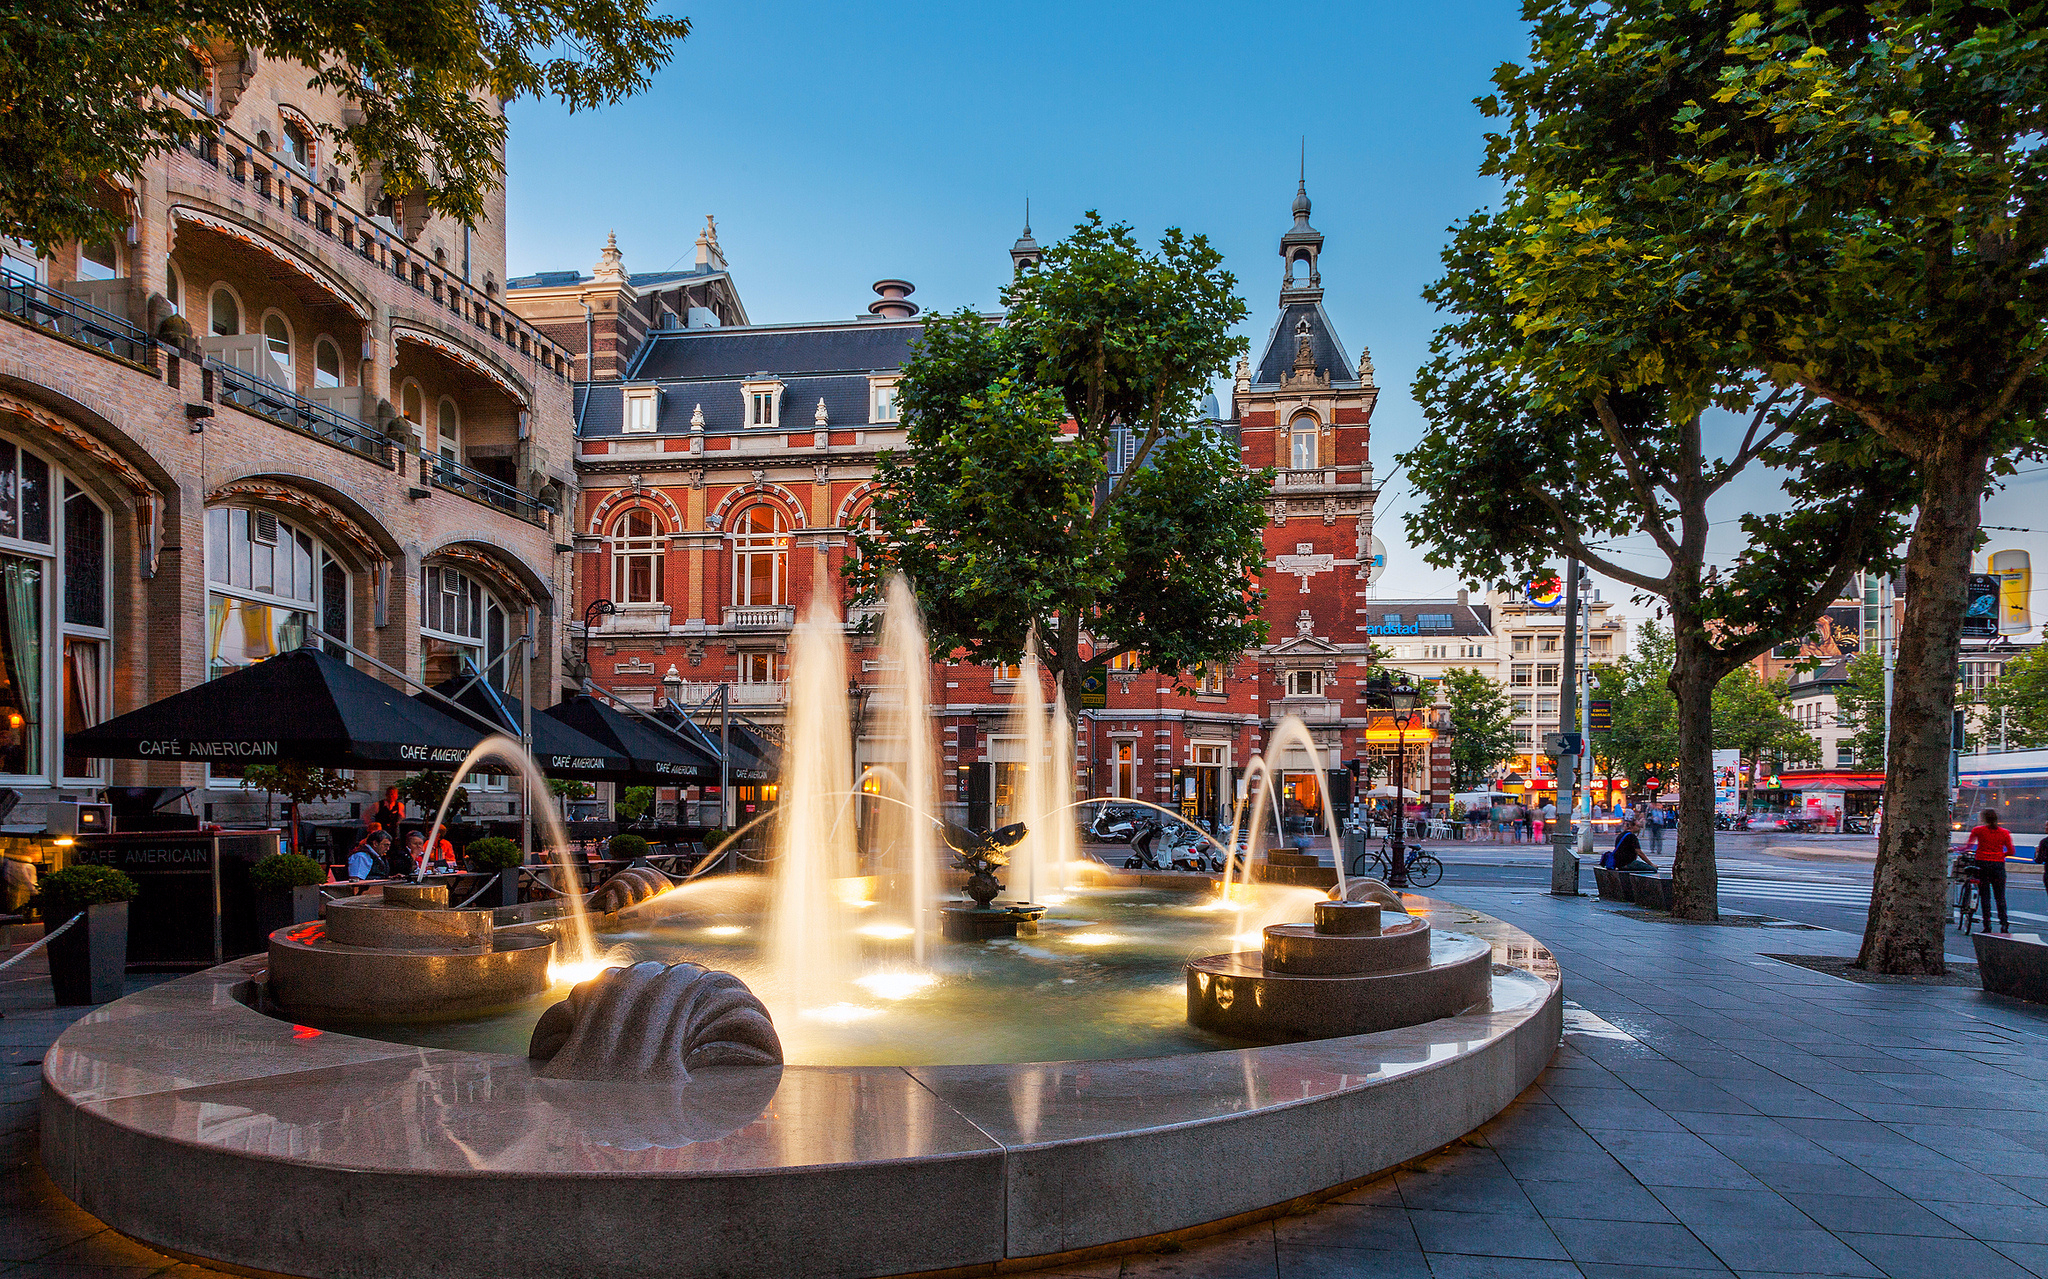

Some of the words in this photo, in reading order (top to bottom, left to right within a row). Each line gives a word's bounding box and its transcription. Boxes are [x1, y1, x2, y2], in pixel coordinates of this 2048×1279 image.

[1366, 621, 1419, 635] andstad
[139, 738, 182, 755] CAFÉ
[189, 741, 278, 756] AMERICAIN
[400, 744, 428, 760] CAFÉ
[430, 748, 480, 763] AMERIC
[552, 754, 571, 768] CAFÉ
[571, 757, 605, 769] AMERICAIN
[656, 762, 671, 774] CAFÉ
[671, 764, 698, 775] AMERICAIN
[78, 846, 118, 864] CAFÉ
[125, 849, 207, 863] AMERICAIN
